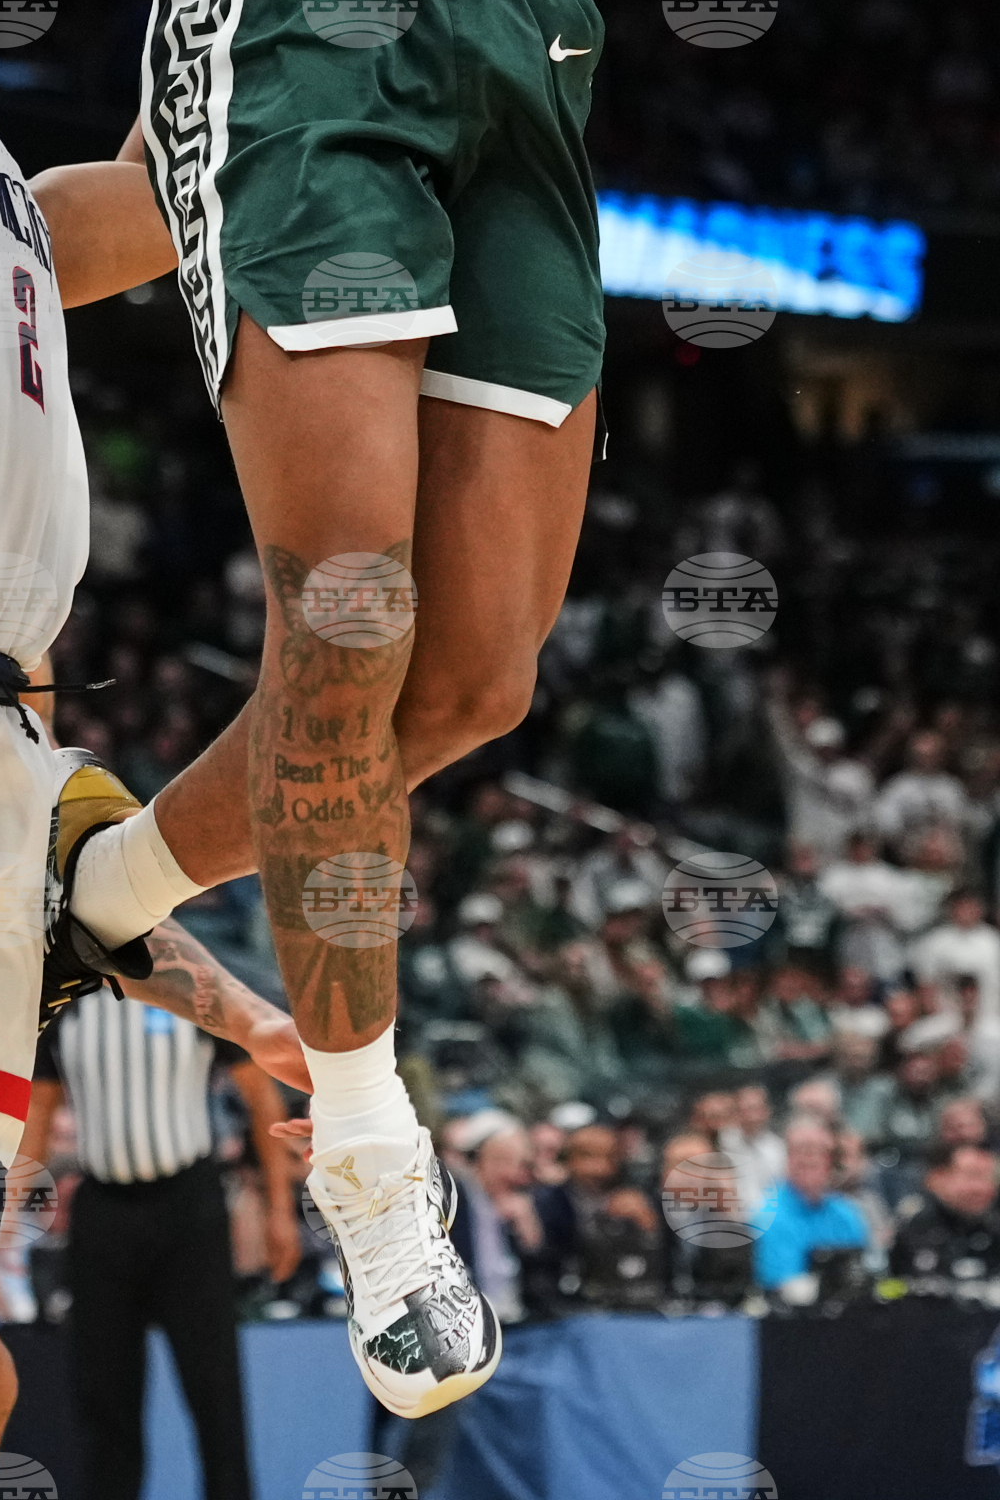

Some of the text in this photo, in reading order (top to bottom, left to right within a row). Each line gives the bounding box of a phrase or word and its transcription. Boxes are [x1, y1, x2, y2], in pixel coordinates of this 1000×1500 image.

[12, 266, 46, 415] 2
[274, 752, 371, 784] Beat The
[291, 796, 356, 824] Odds
